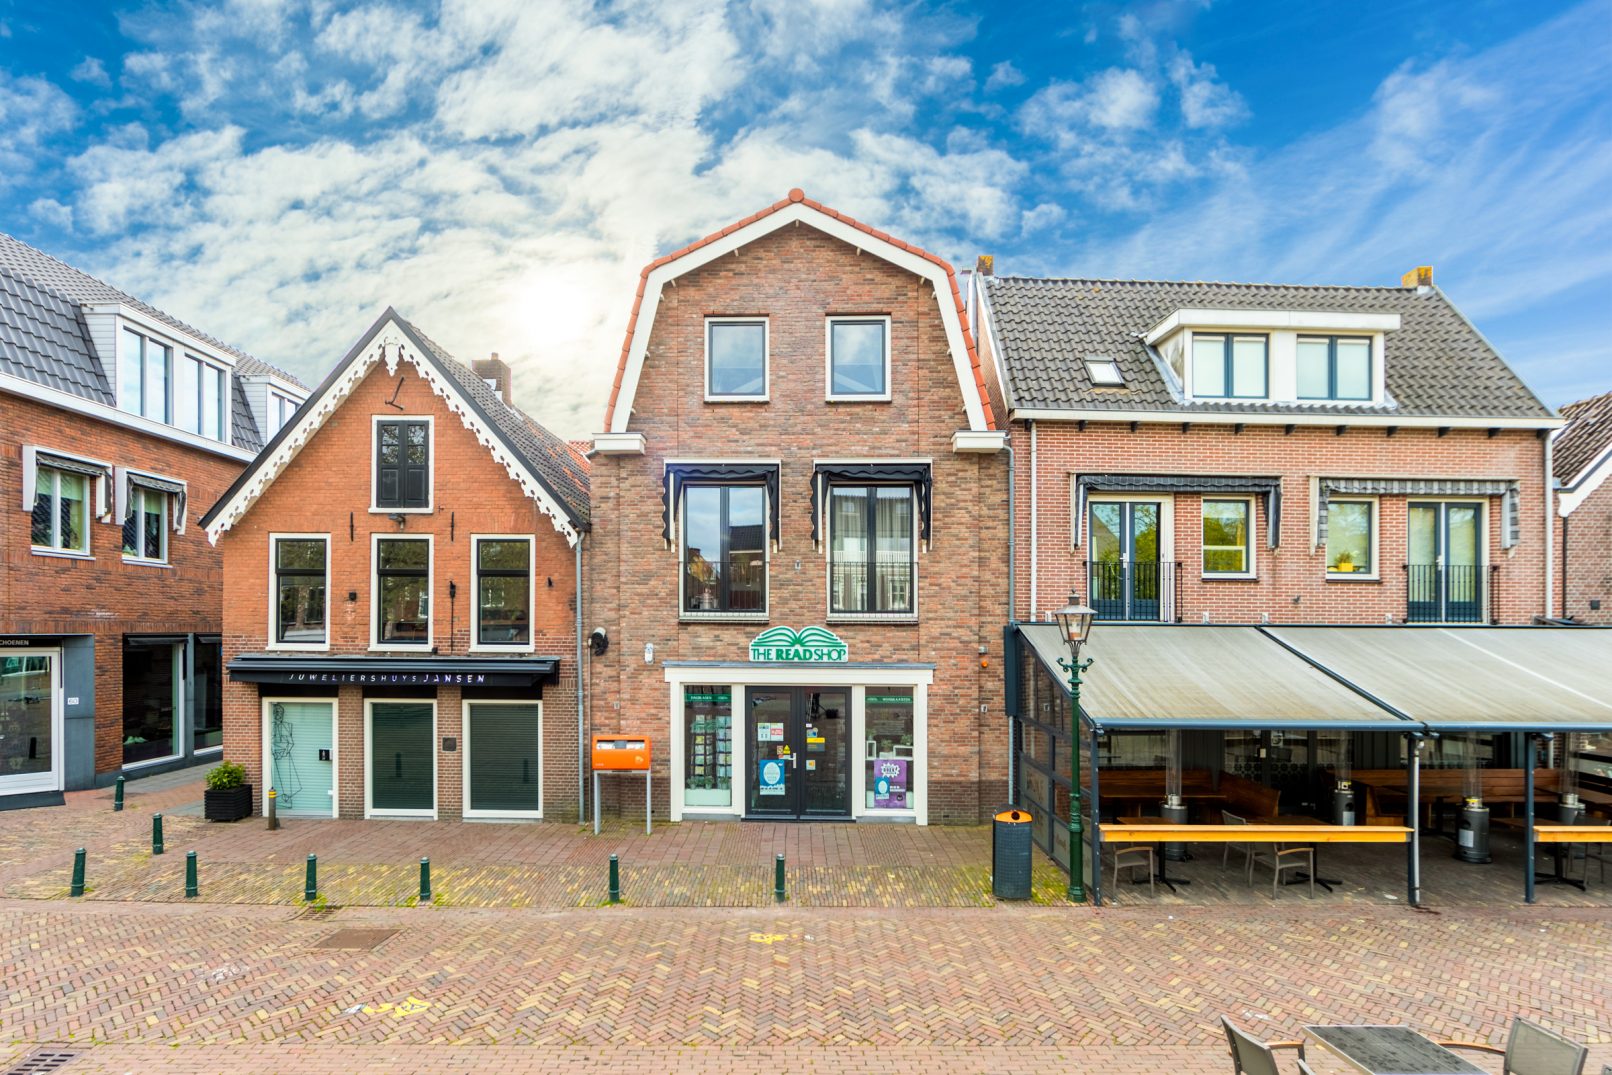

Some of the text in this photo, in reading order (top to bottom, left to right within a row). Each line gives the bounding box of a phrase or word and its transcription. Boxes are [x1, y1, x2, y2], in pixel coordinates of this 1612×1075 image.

[750, 648, 773, 660] THE
[288, 673, 485, 683] JUWELIERSHUYS JANSEN
